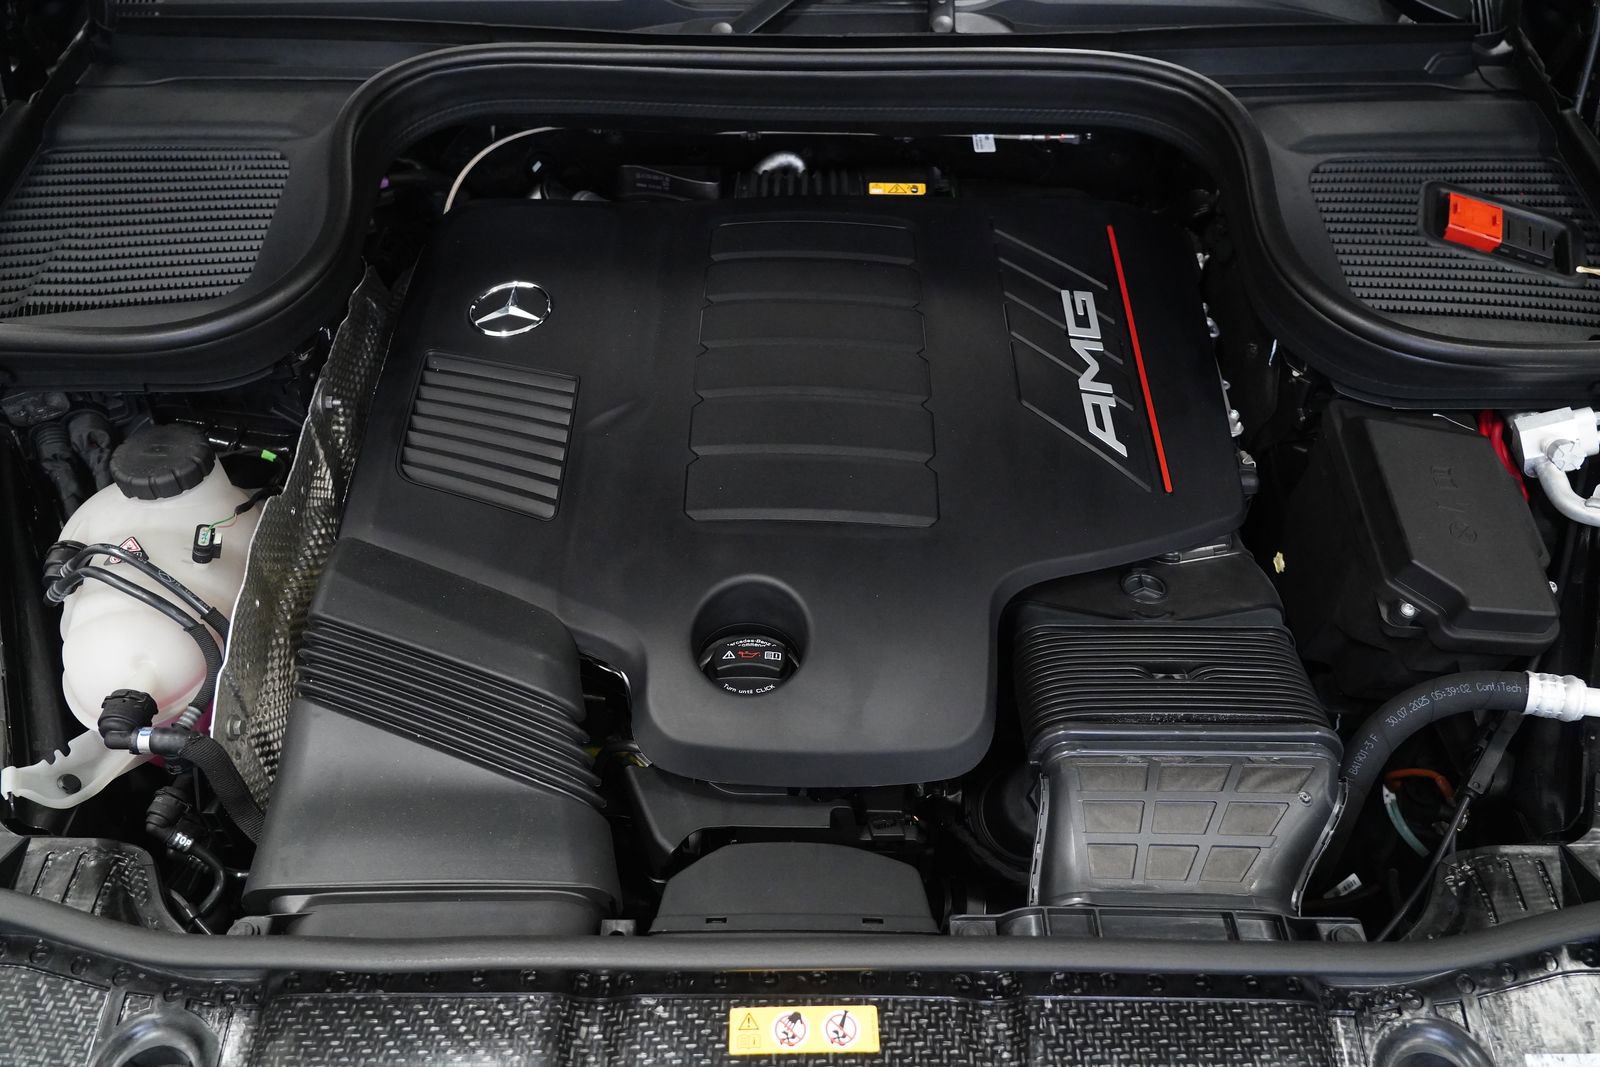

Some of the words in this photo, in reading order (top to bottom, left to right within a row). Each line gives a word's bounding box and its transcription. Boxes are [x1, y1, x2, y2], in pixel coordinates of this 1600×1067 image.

[1061, 289, 1128, 458] AMG
[723, 683, 737, 693] Turn
[755, 683, 776, 694] CLICK
[1431, 683, 1472, 700] 05:39:02
[174, 832, 193, 847] TOP
